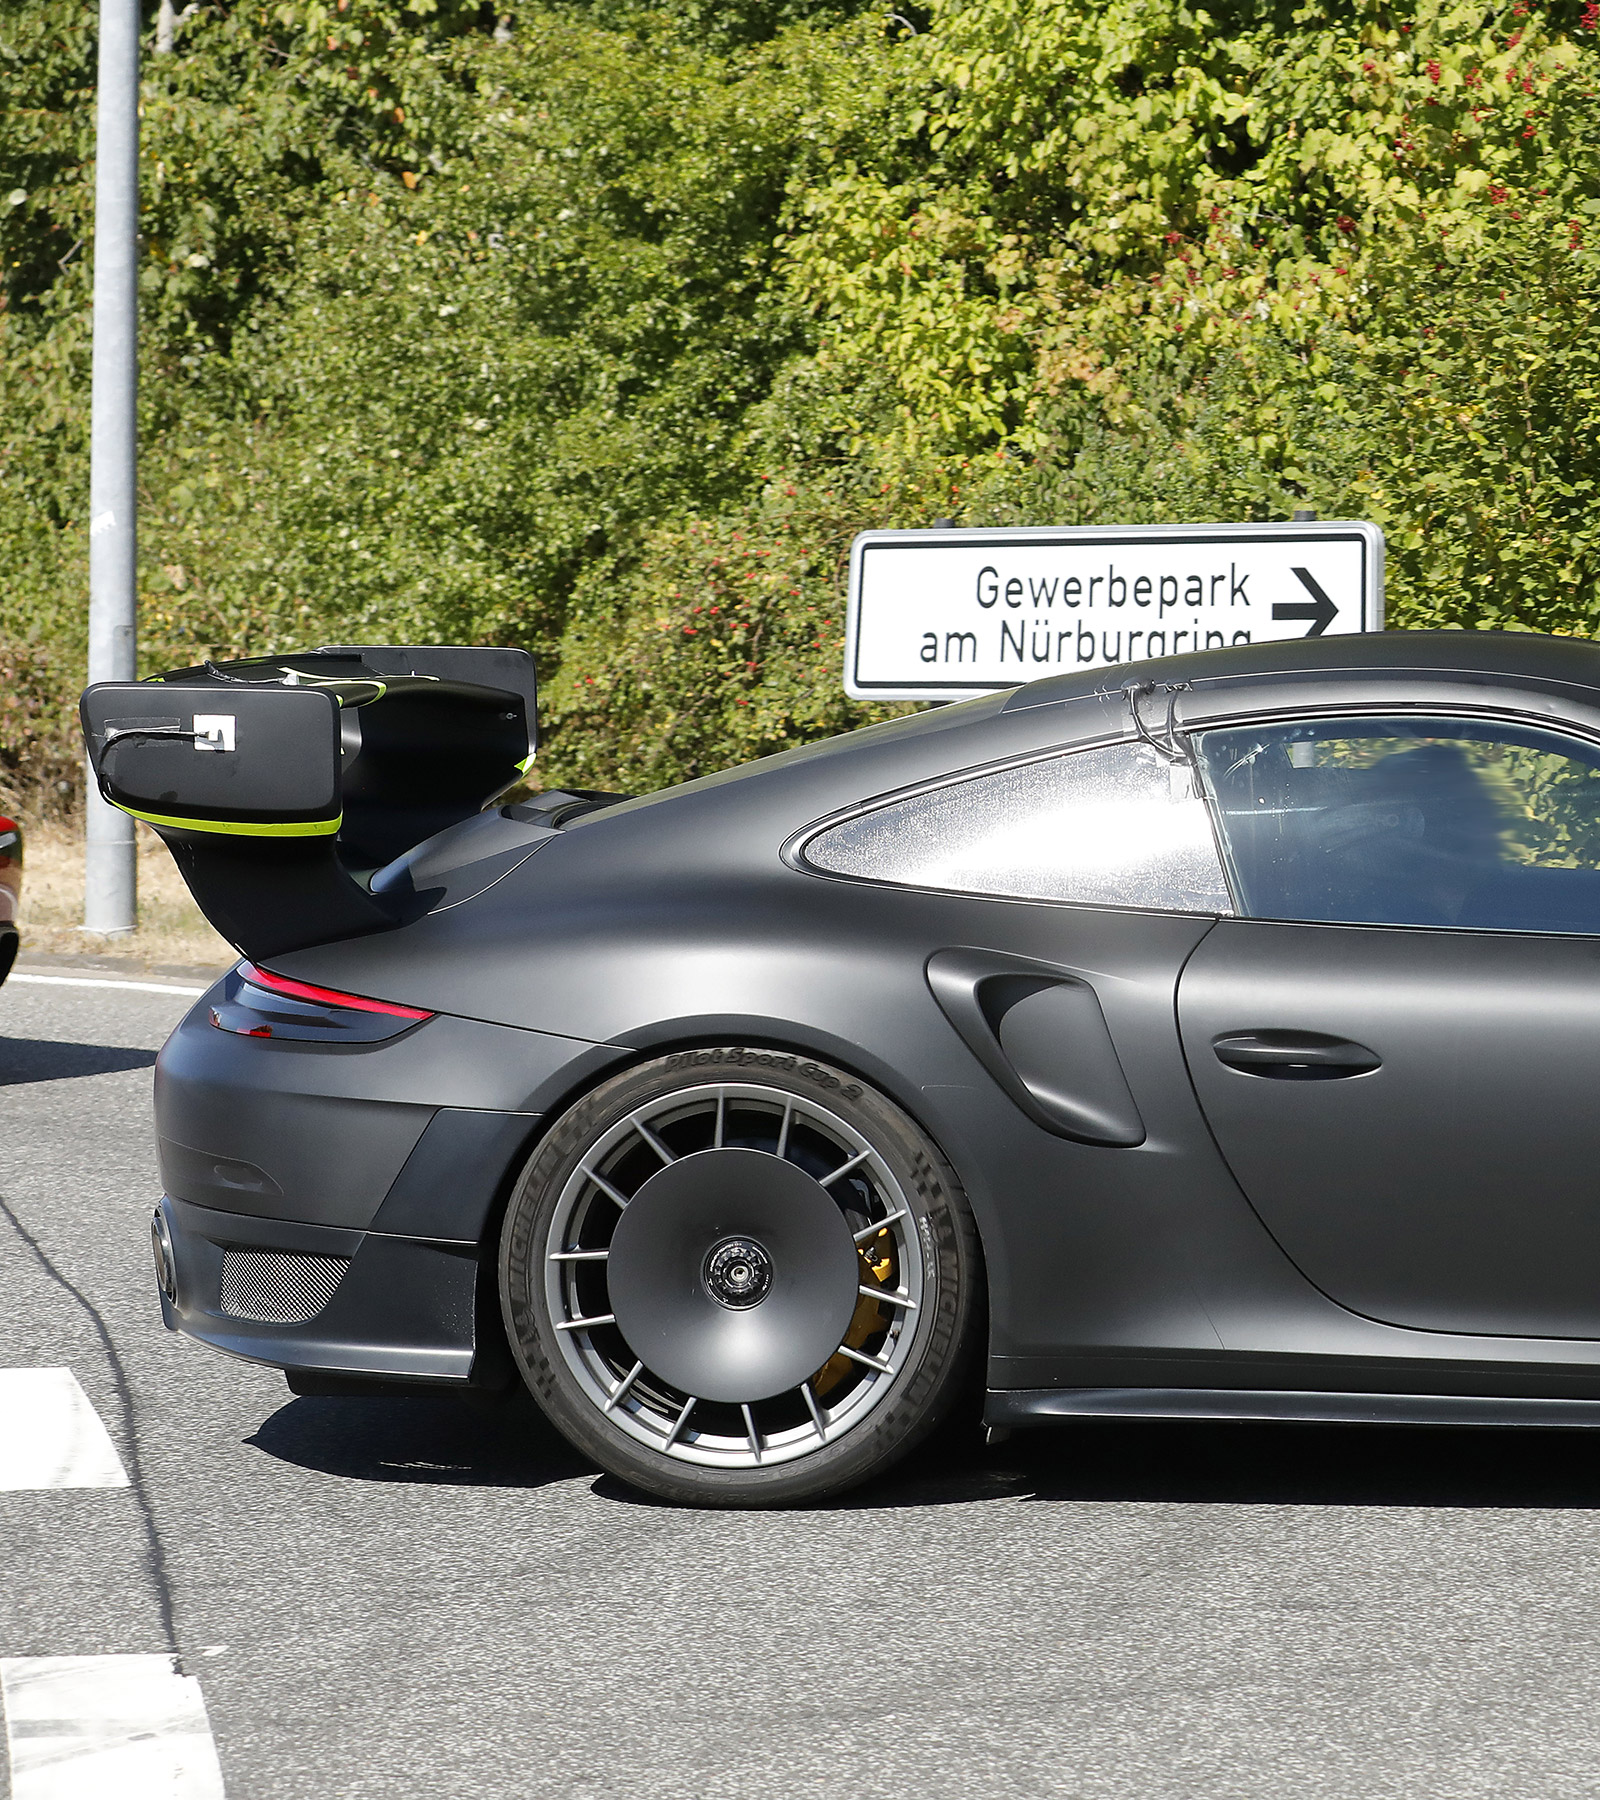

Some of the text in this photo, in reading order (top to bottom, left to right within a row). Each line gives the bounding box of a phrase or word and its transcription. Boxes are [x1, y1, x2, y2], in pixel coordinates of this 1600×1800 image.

[976, 562, 1251, 619] Gewerbepark
[920, 631, 977, 663] am
[799, 1061, 842, 1090] Cup
[509, 1145, 561, 1301] MICHELIN
[908, 1249, 959, 1402] MICHELIN
